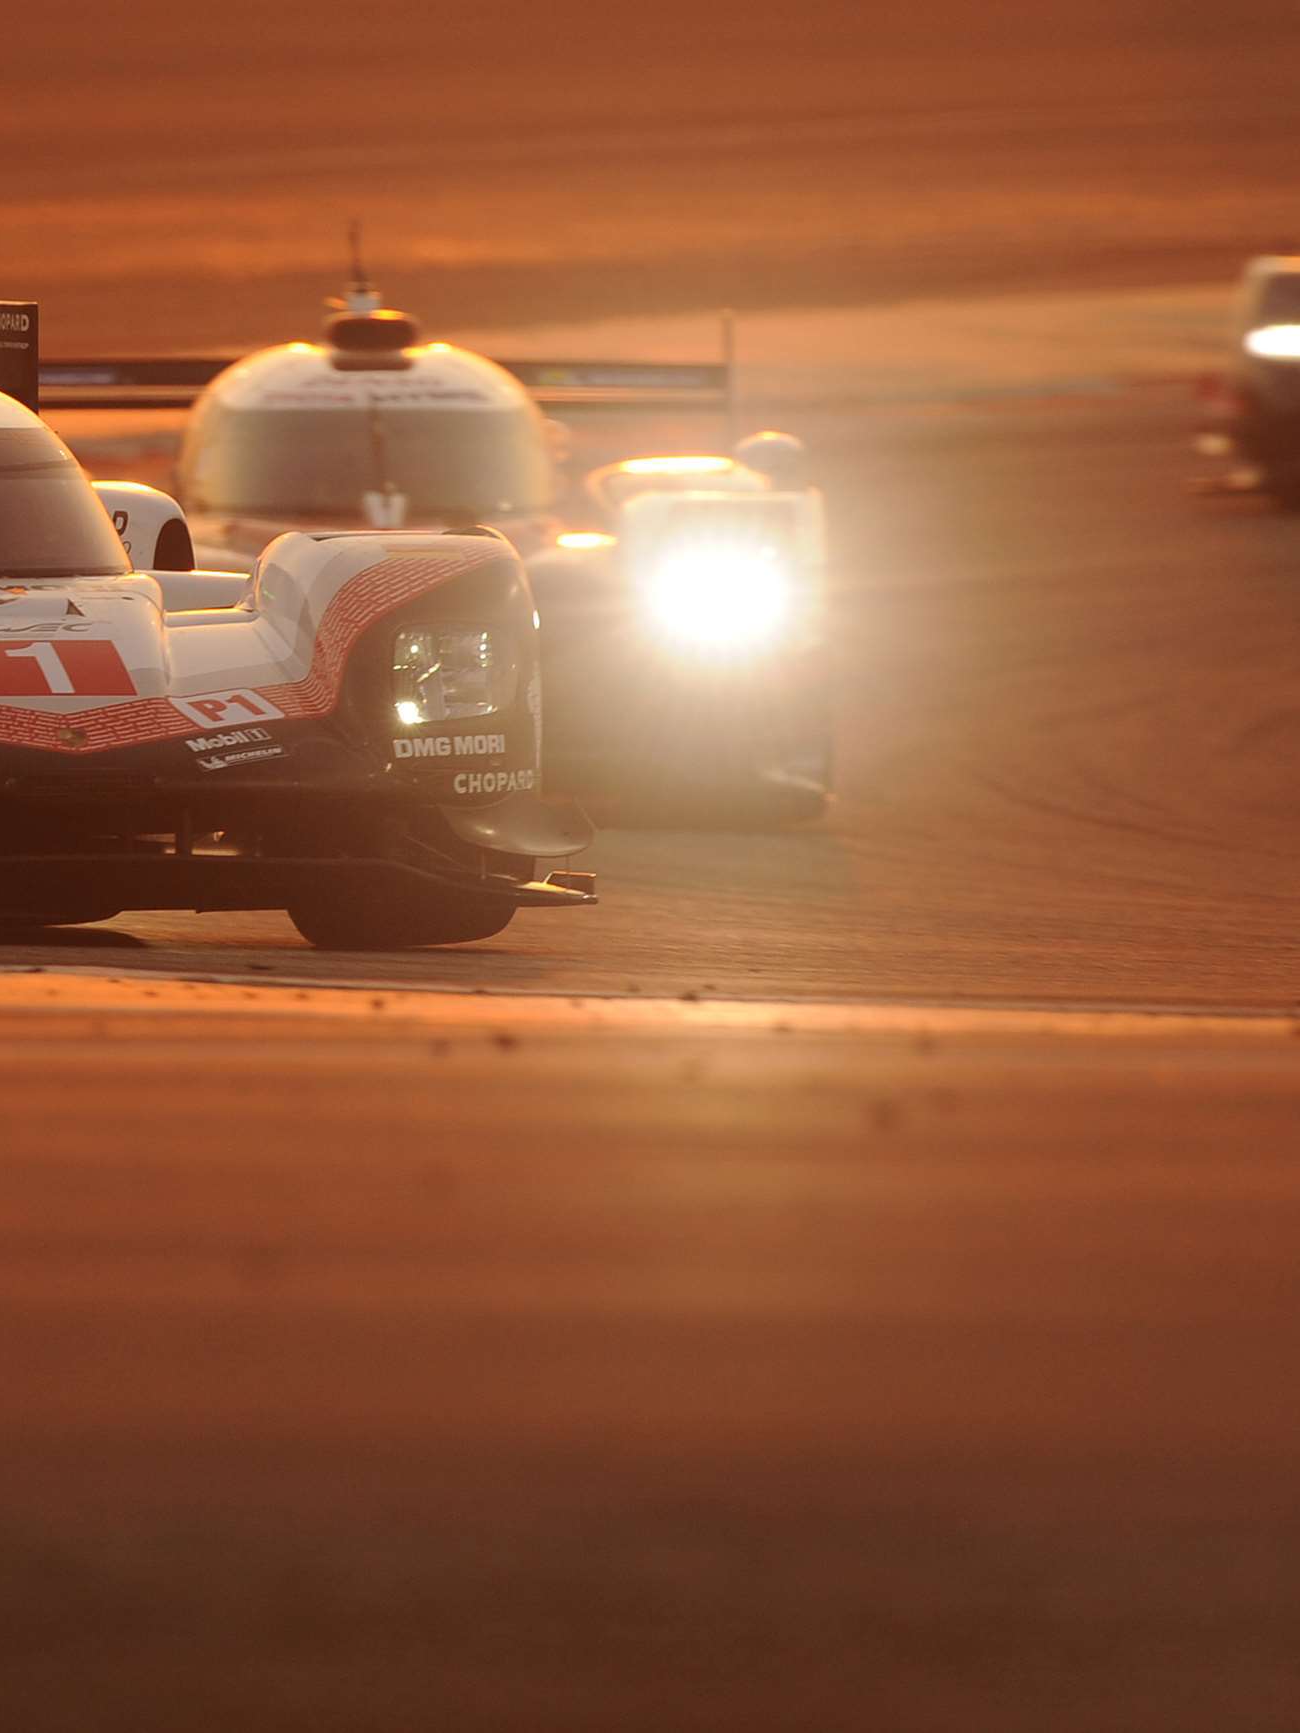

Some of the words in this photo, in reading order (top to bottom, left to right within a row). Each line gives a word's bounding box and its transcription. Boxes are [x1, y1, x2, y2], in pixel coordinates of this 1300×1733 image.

[4, 642, 76, 694] 1
[187, 694, 268, 722] P1
[185, 731, 250, 753] Mobil
[393, 736, 451, 759] DMG
[453, 733, 506, 756] MORI
[453, 769, 534, 795] CHOPARD
